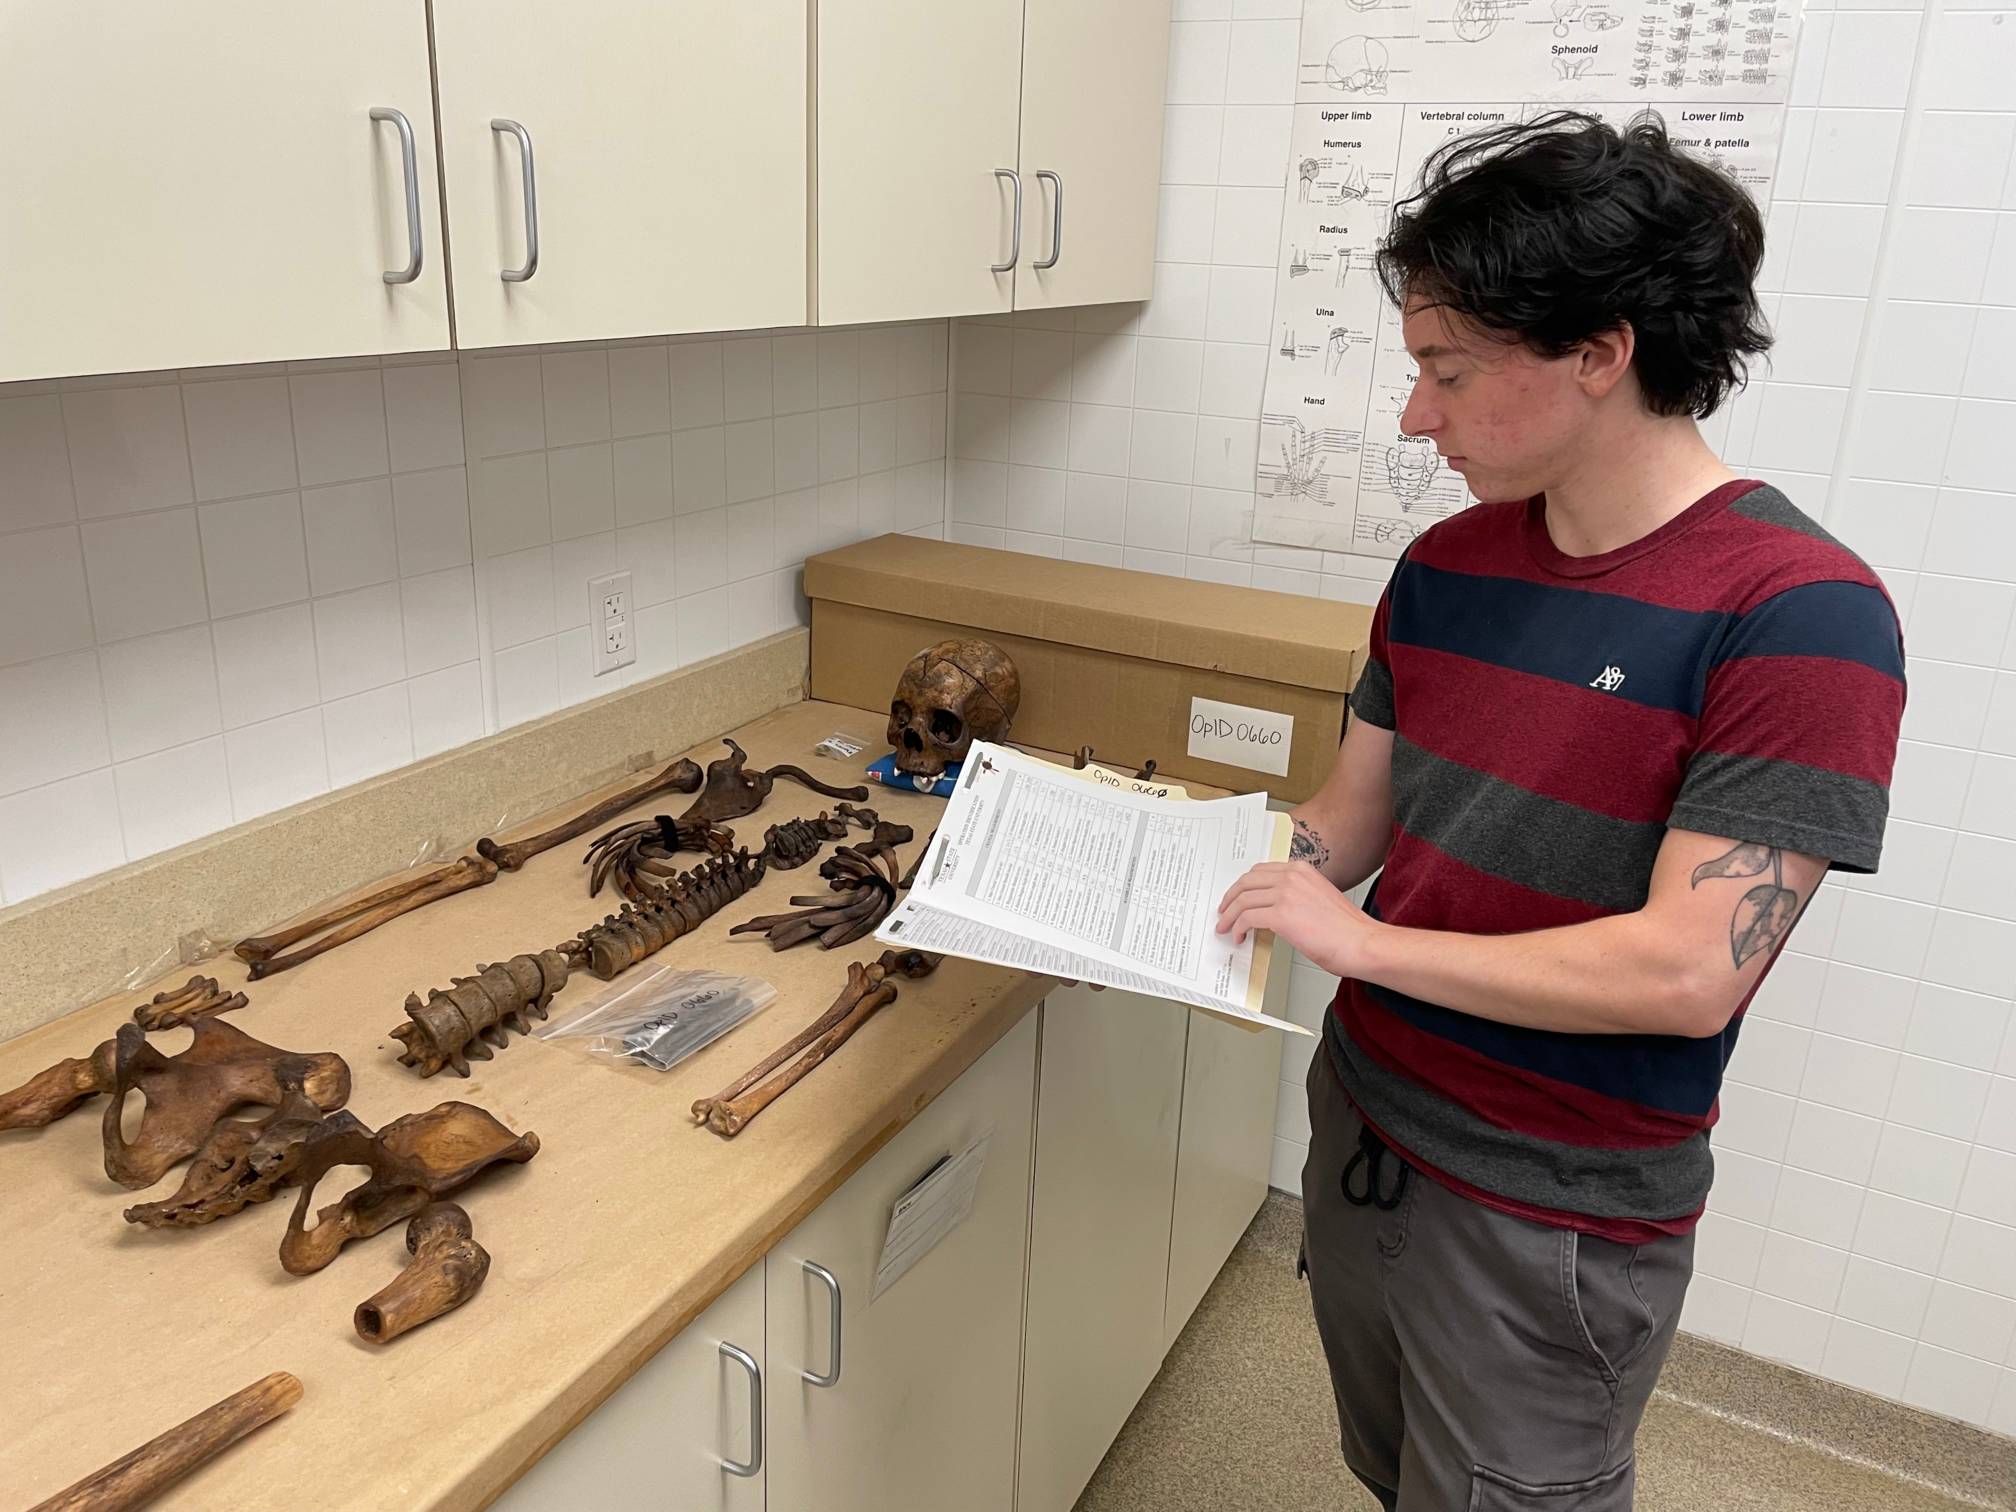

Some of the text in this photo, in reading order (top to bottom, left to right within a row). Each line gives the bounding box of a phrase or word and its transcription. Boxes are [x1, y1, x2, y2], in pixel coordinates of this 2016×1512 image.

[1551, 44, 1598, 55] Sphenoid
[1321, 111, 1372, 121] Upper limb
[1420, 111, 1504, 121] Vertebral column
[1682, 111, 1744, 121] Lower limb
[1448, 127, 1455, 135] C
[1323, 140, 1362, 148] Humerus
[1669, 137, 1750, 148] Femur & patella
[1319, 225, 1348, 234] Radius
[1316, 308, 1334, 316] Ulna
[1303, 396, 1325, 405] Hand
[1397, 434, 1430, 444] Sacrum
[1589, 665, 1626, 691] A87
[1191, 714, 1282, 744] OpID 0660
